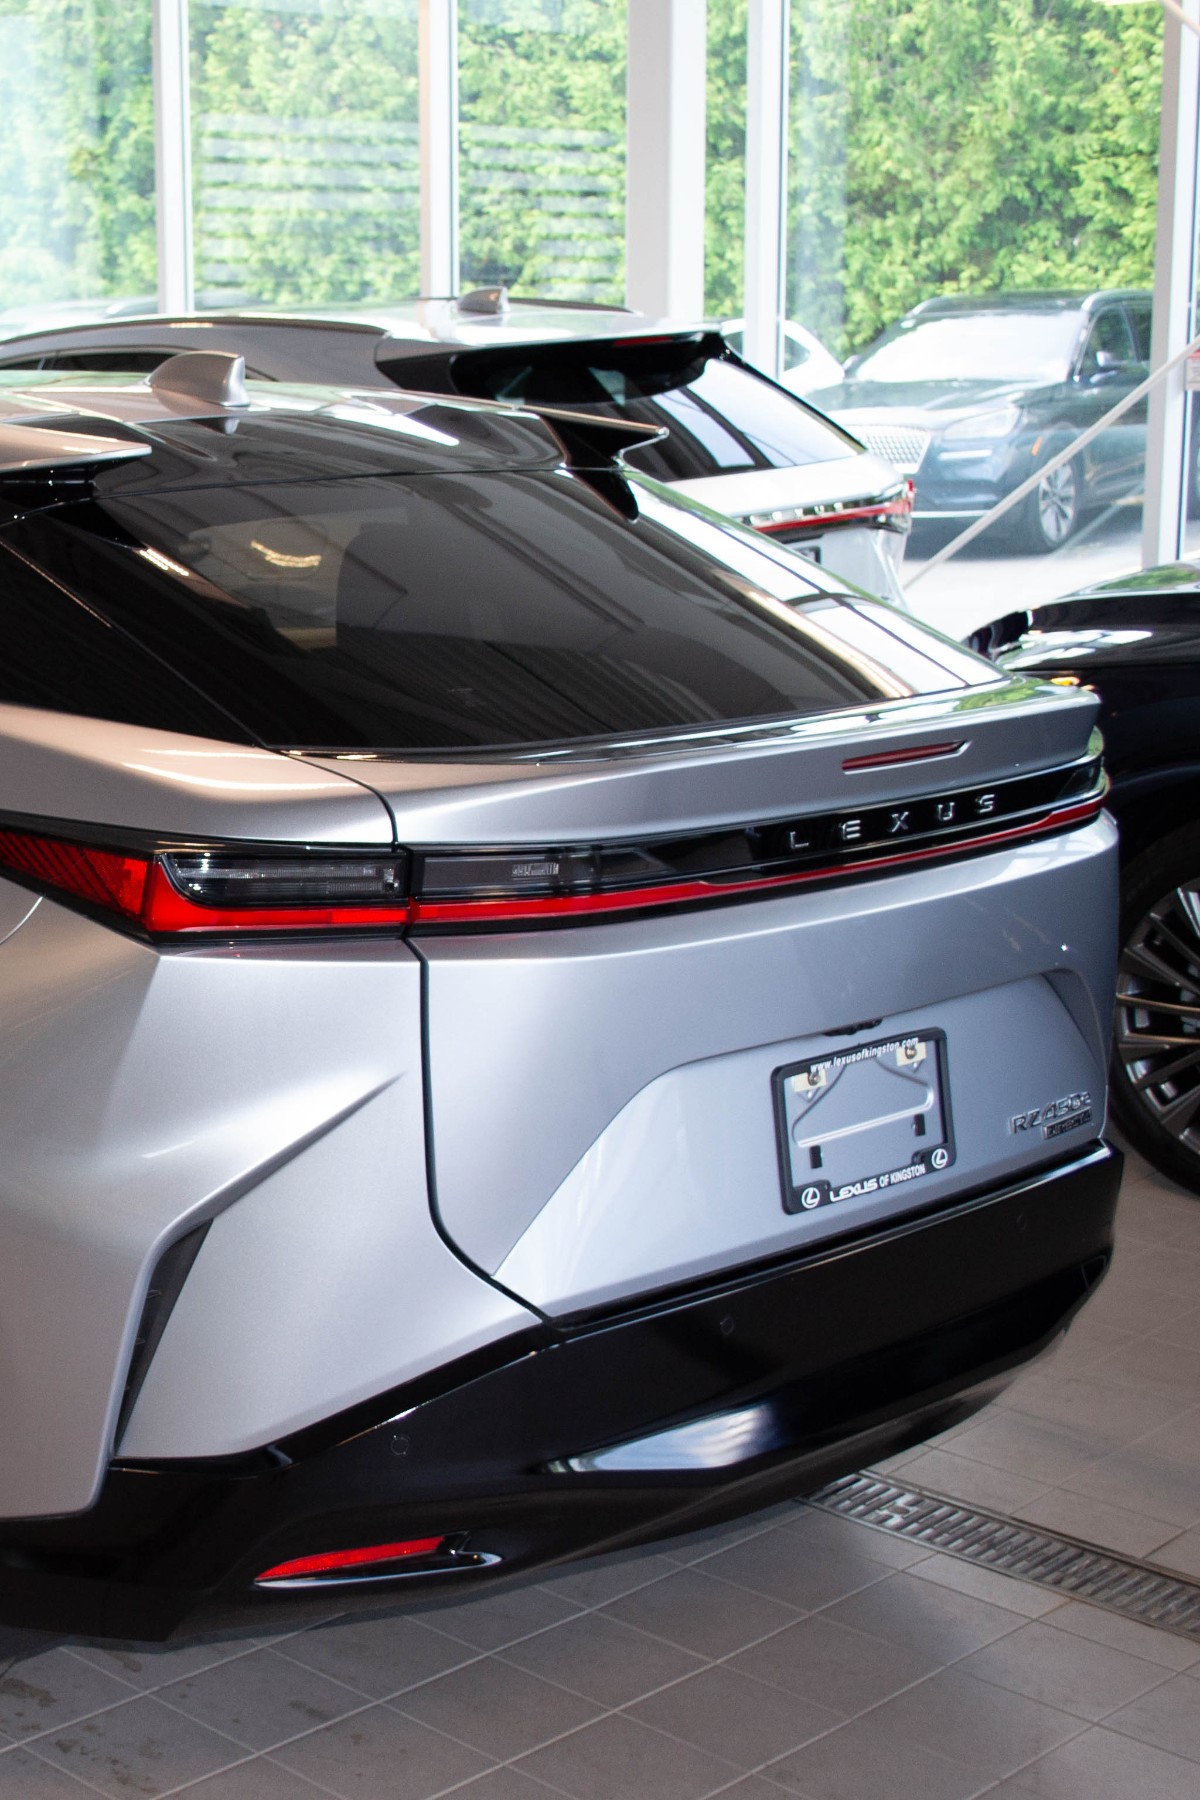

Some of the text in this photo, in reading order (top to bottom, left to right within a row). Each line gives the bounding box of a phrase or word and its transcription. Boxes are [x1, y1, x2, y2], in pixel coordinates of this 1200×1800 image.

[789, 794, 995, 849] LEXUS
[810, 1037, 919, 1073] www.lexusofkingston.com
[1008, 1107, 1042, 1136] RZ
[829, 1163, 926, 1202] LEXUS OF KINGSTON
